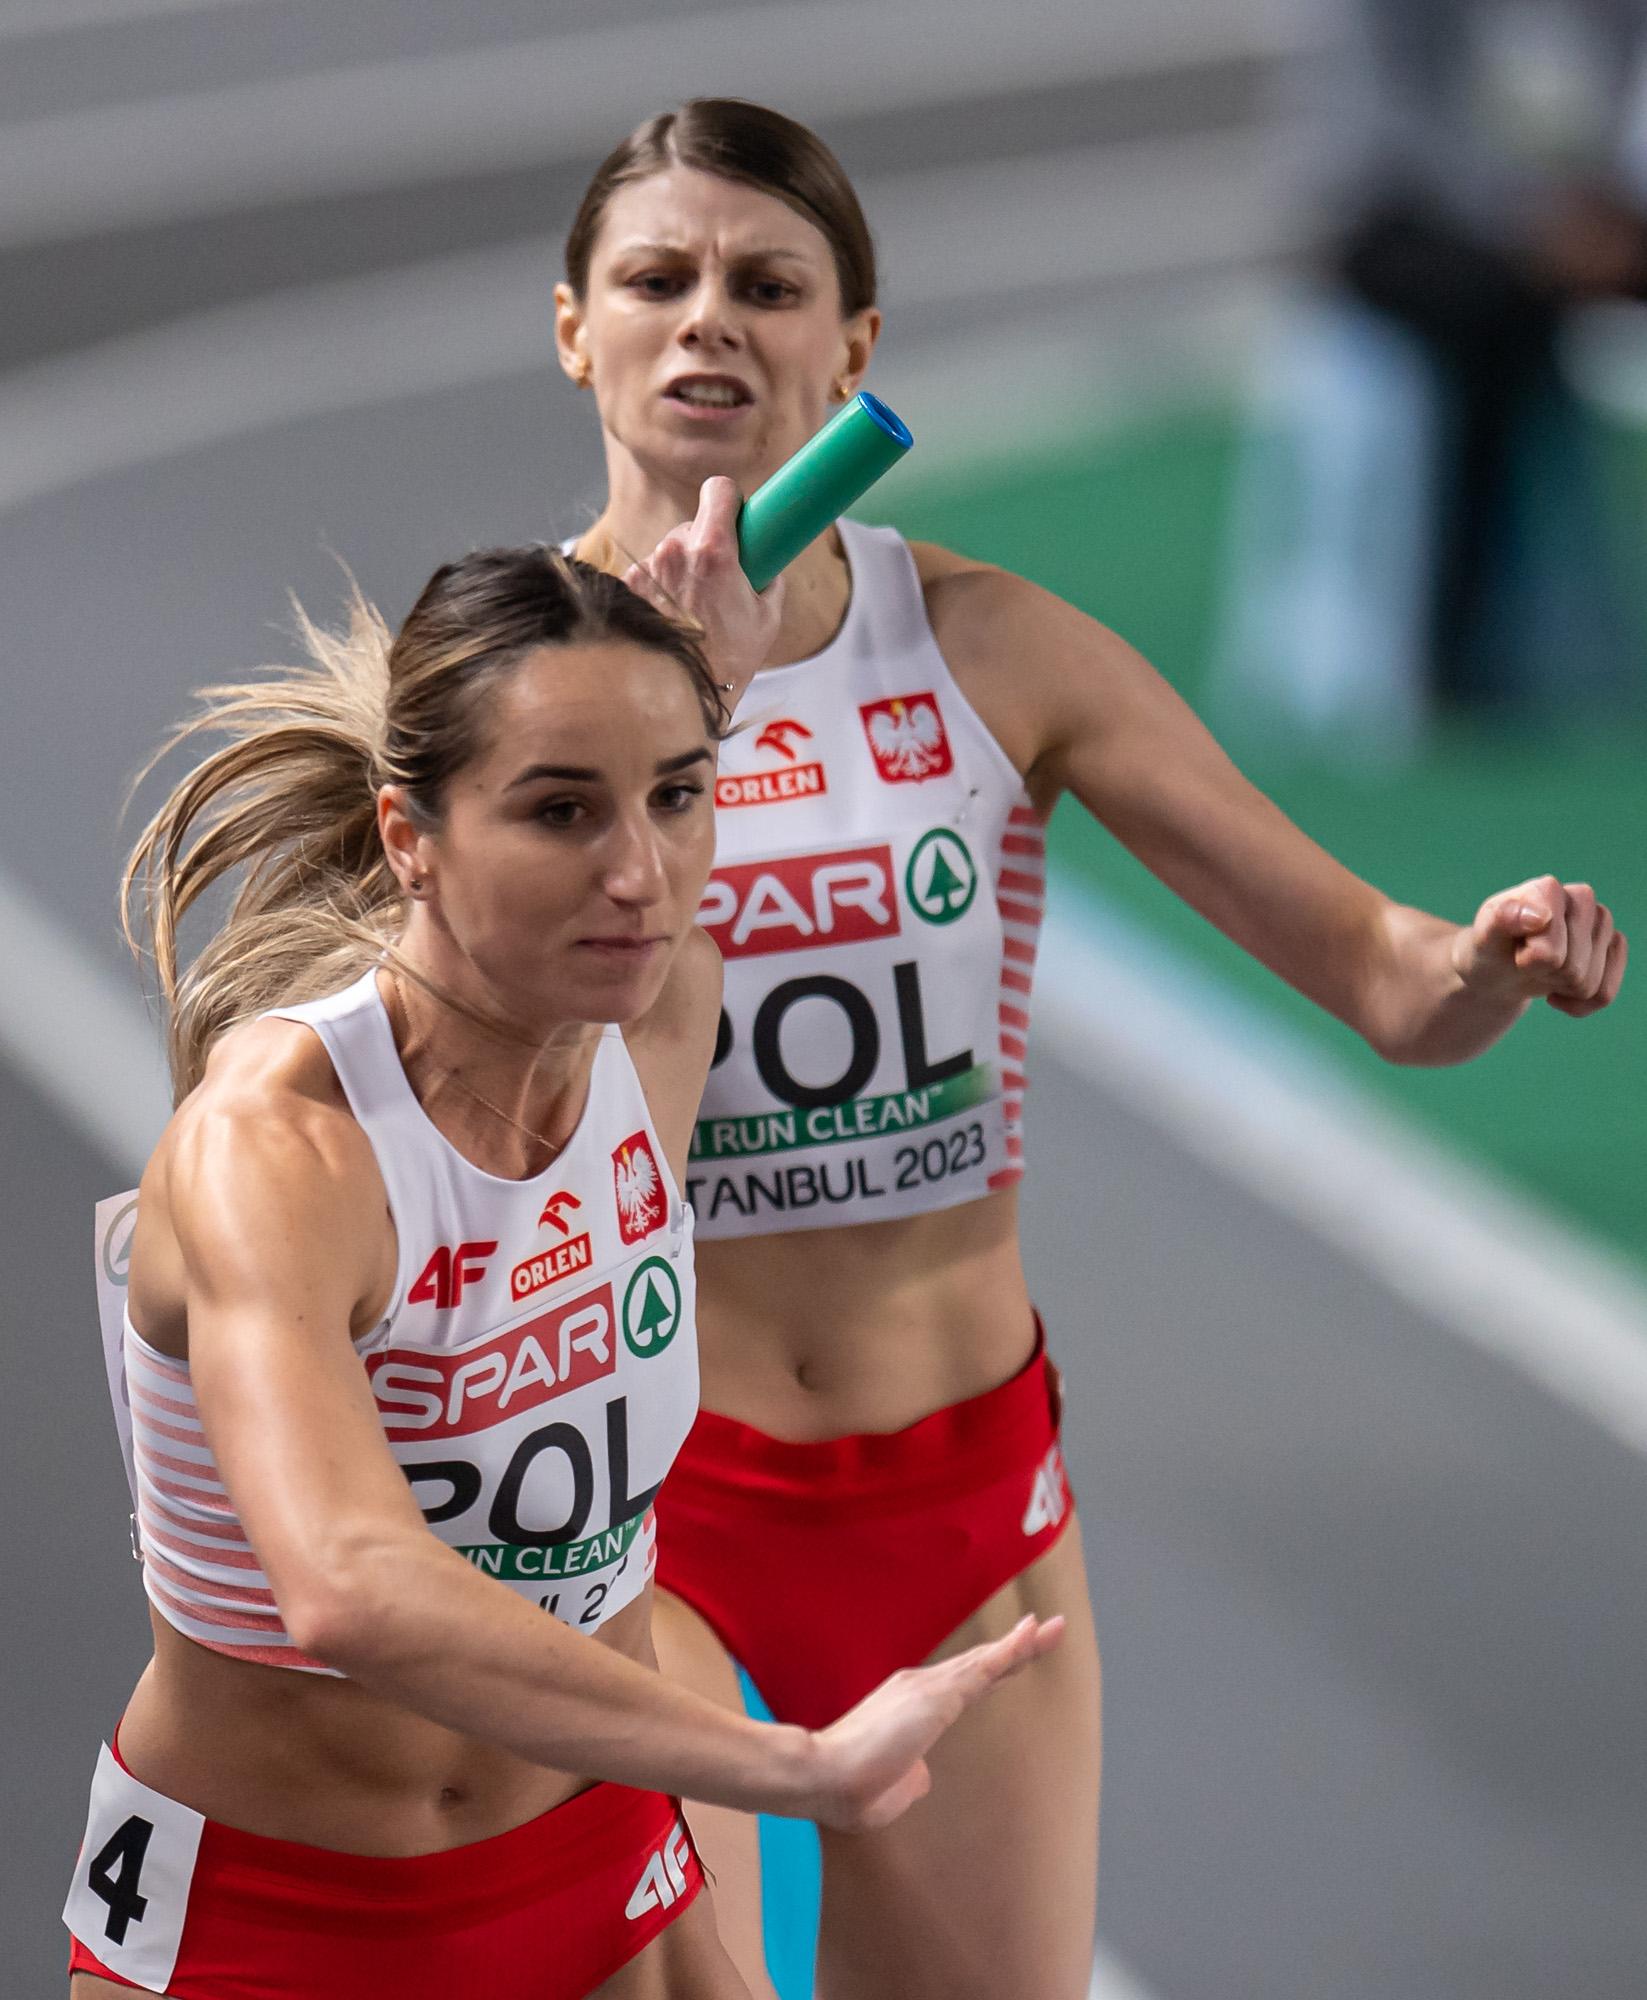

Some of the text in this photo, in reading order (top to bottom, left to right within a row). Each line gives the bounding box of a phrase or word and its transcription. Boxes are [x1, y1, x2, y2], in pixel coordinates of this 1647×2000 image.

[717, 767, 822, 804] ORLEN
[709, 960, 974, 1110] OL
[712, 1111, 796, 1153] RUN
[894, 1122, 988, 1193] 2023
[407, 1240, 499, 1310] 4F
[514, 1239, 589, 1295] ORLEN
[371, 1302, 611, 1429] SPAR
[398, 1395, 665, 1548] POL
[88, 1814, 154, 1946] 4
[625, 1822, 689, 1921] 4F
